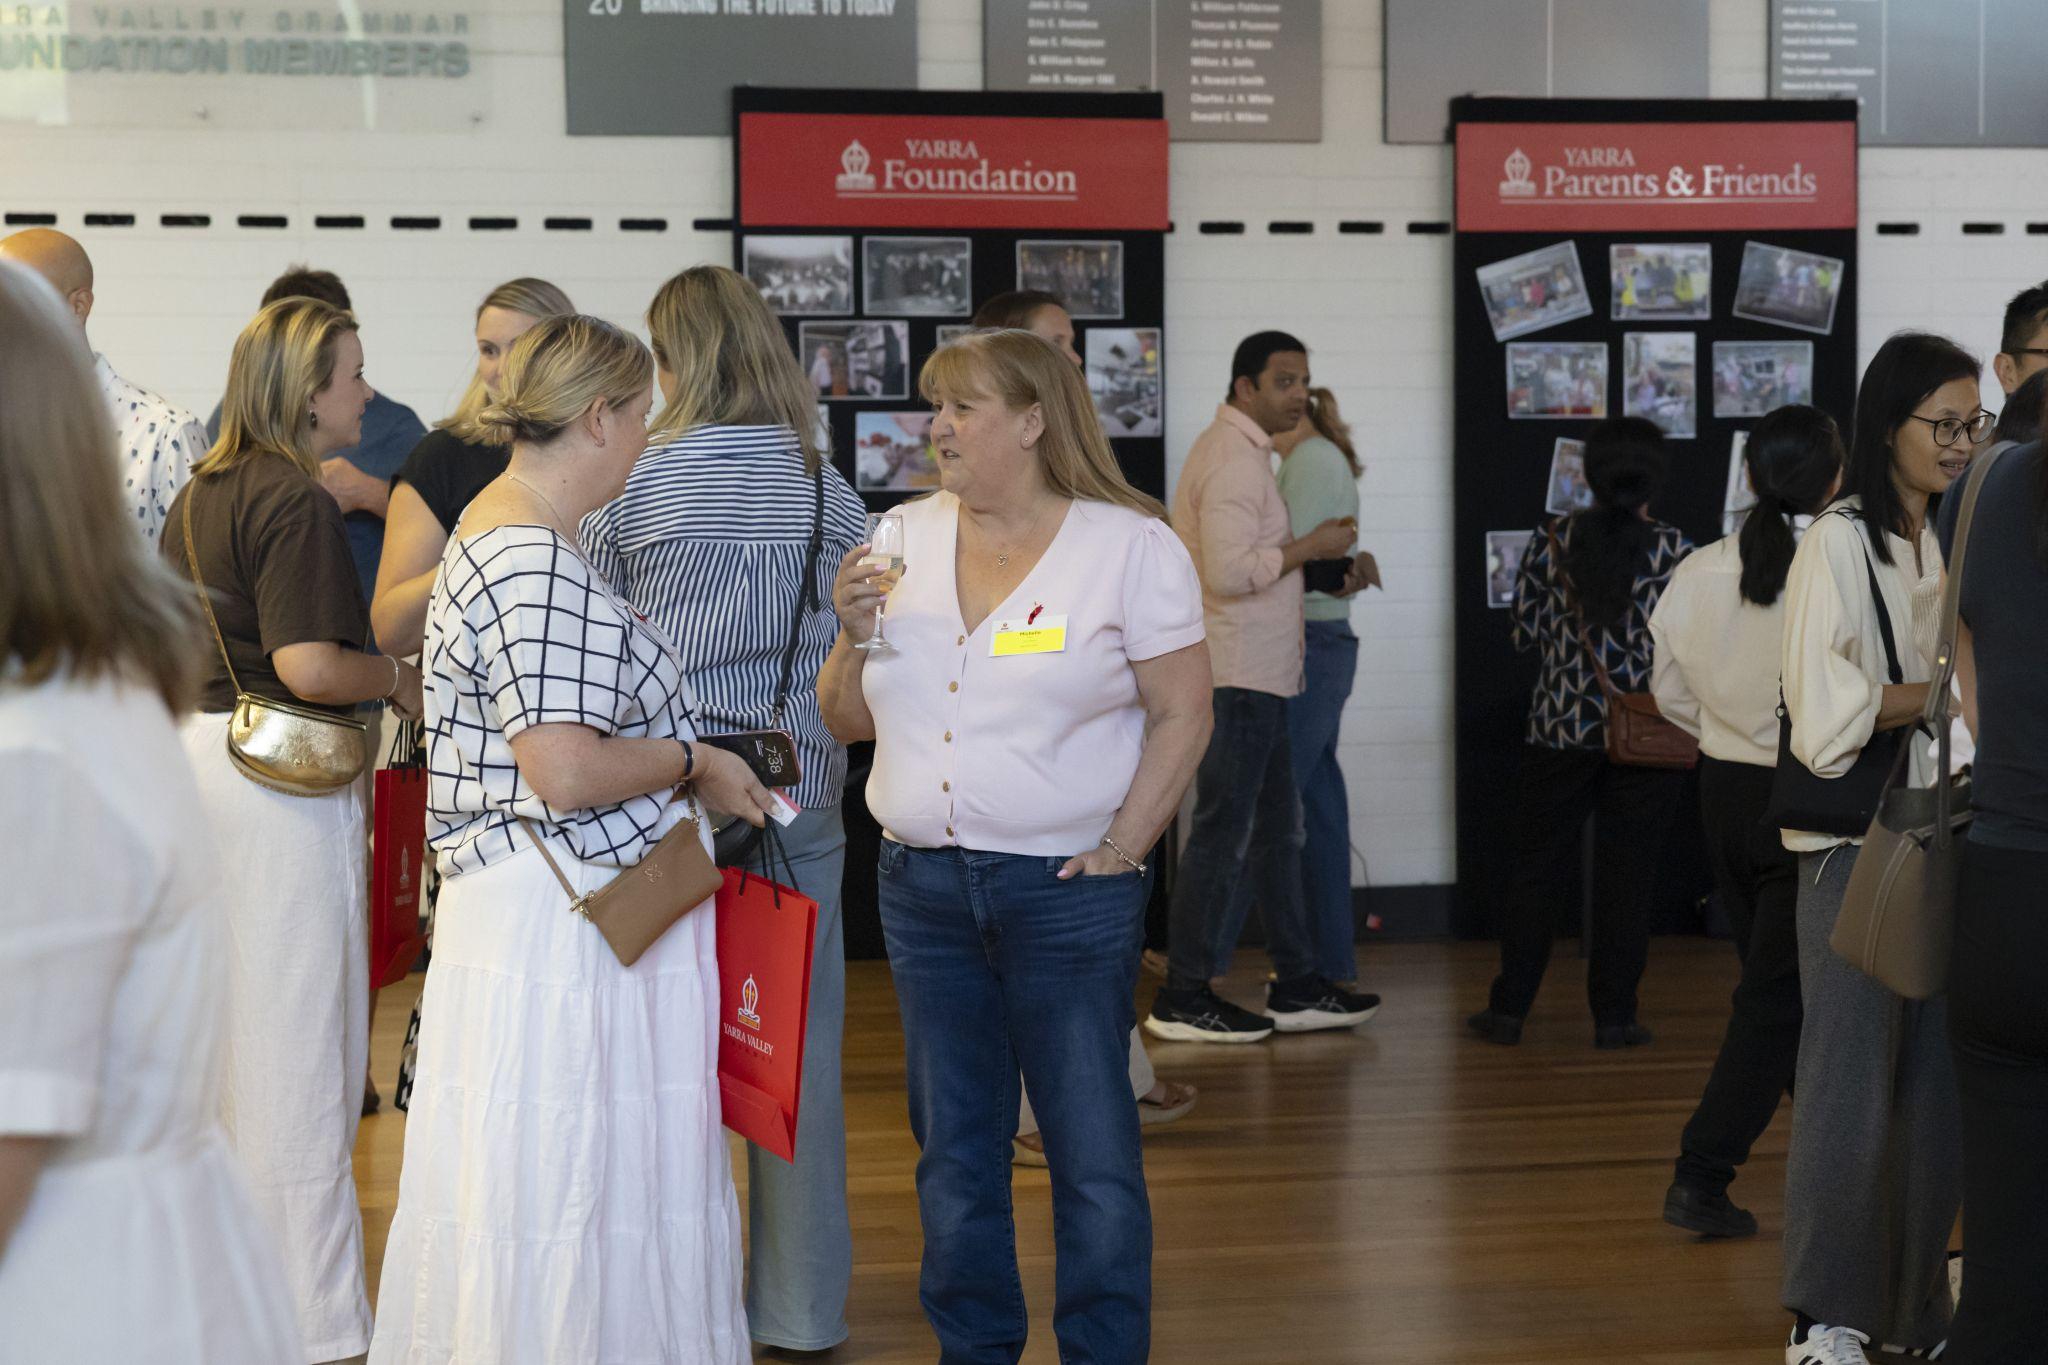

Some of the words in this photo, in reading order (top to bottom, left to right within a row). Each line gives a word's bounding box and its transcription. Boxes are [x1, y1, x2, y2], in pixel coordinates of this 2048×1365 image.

[93, 6, 246, 28] VALLEY
[275, 11, 469, 33] GRAMMAR
[822, 0, 842, 15] TO
[244, 38, 470, 78] MEMBERS
[905, 138, 979, 160] YARRA
[1564, 147, 1636, 168] YARRA
[883, 159, 1078, 193] Foundation
[1544, 165, 1661, 198] Parents
[1665, 165, 1697, 198] &
[1702, 162, 1817, 197] Friends
[764, 745, 782, 774] 7:38
[723, 1022, 747, 1044] YARRA
[747, 1033, 774, 1056] VALLEY
